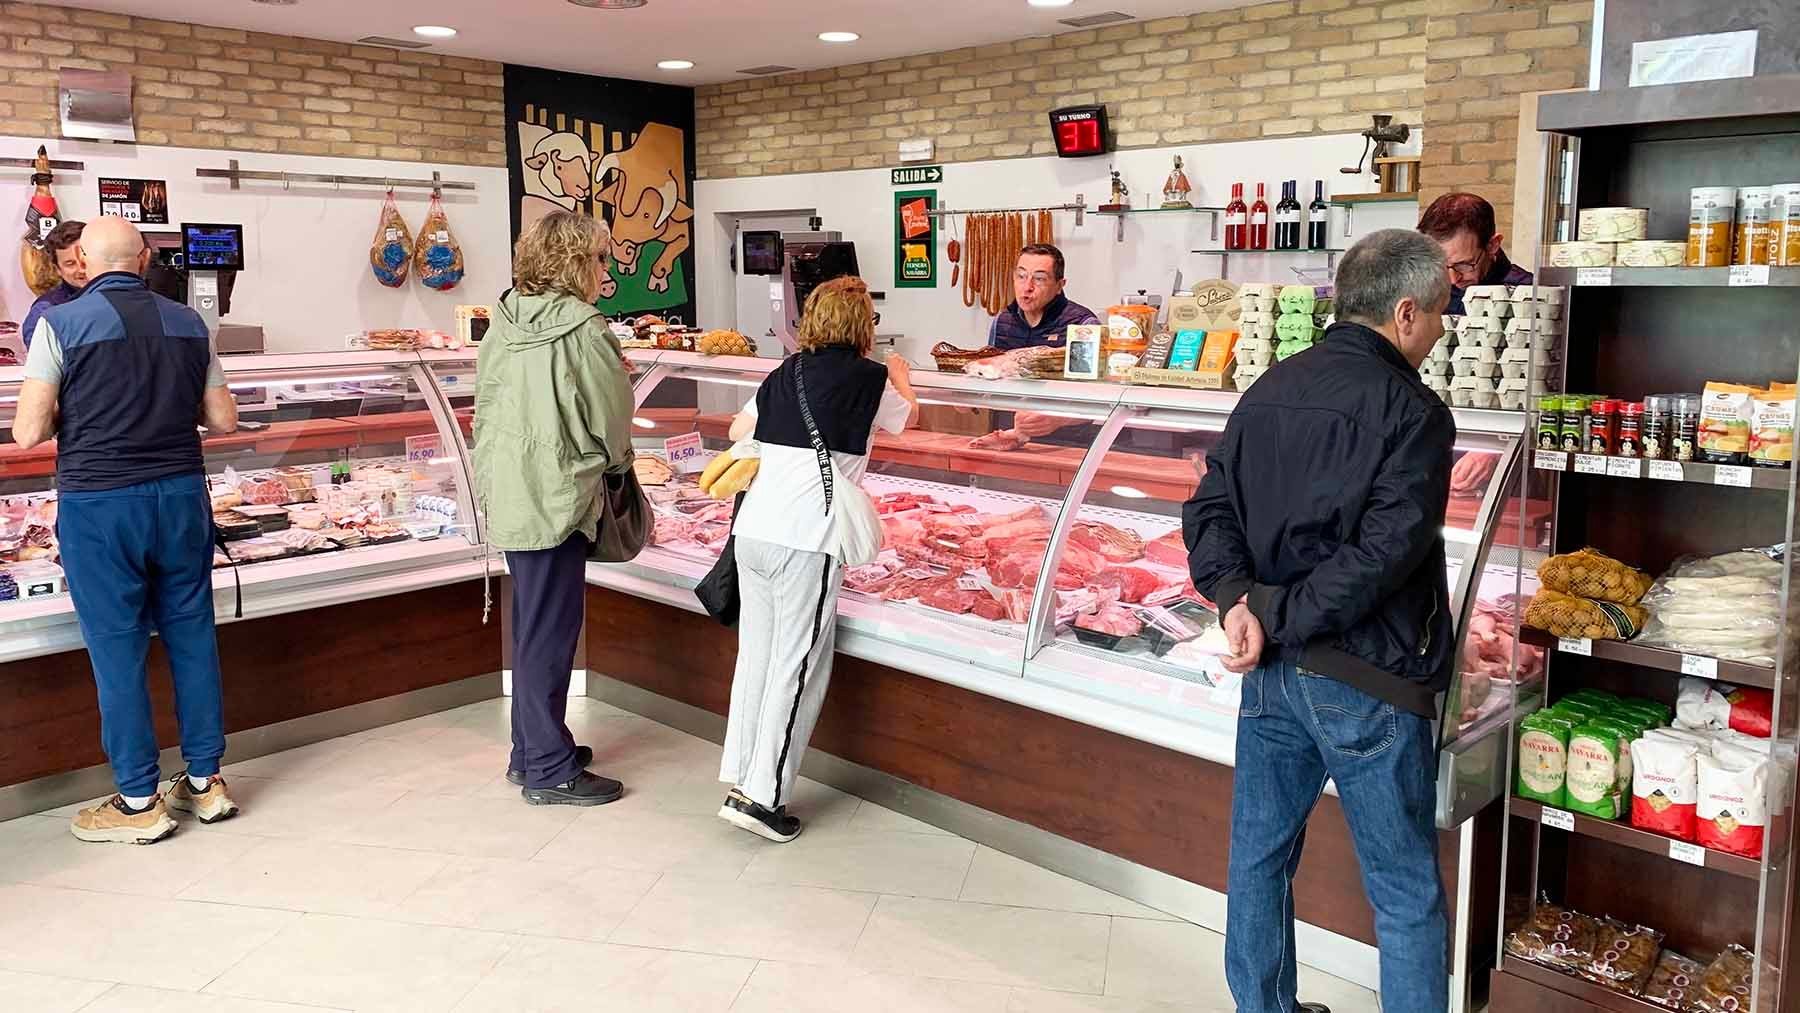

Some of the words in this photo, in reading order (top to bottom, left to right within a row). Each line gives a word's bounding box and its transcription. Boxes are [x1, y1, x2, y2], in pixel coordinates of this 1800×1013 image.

[1068, 112, 1091, 120] TURNO
[893, 168, 927, 182] SALIDA
[670, 447, 695, 461] 16,50
[818, 448, 830, 465] THE
